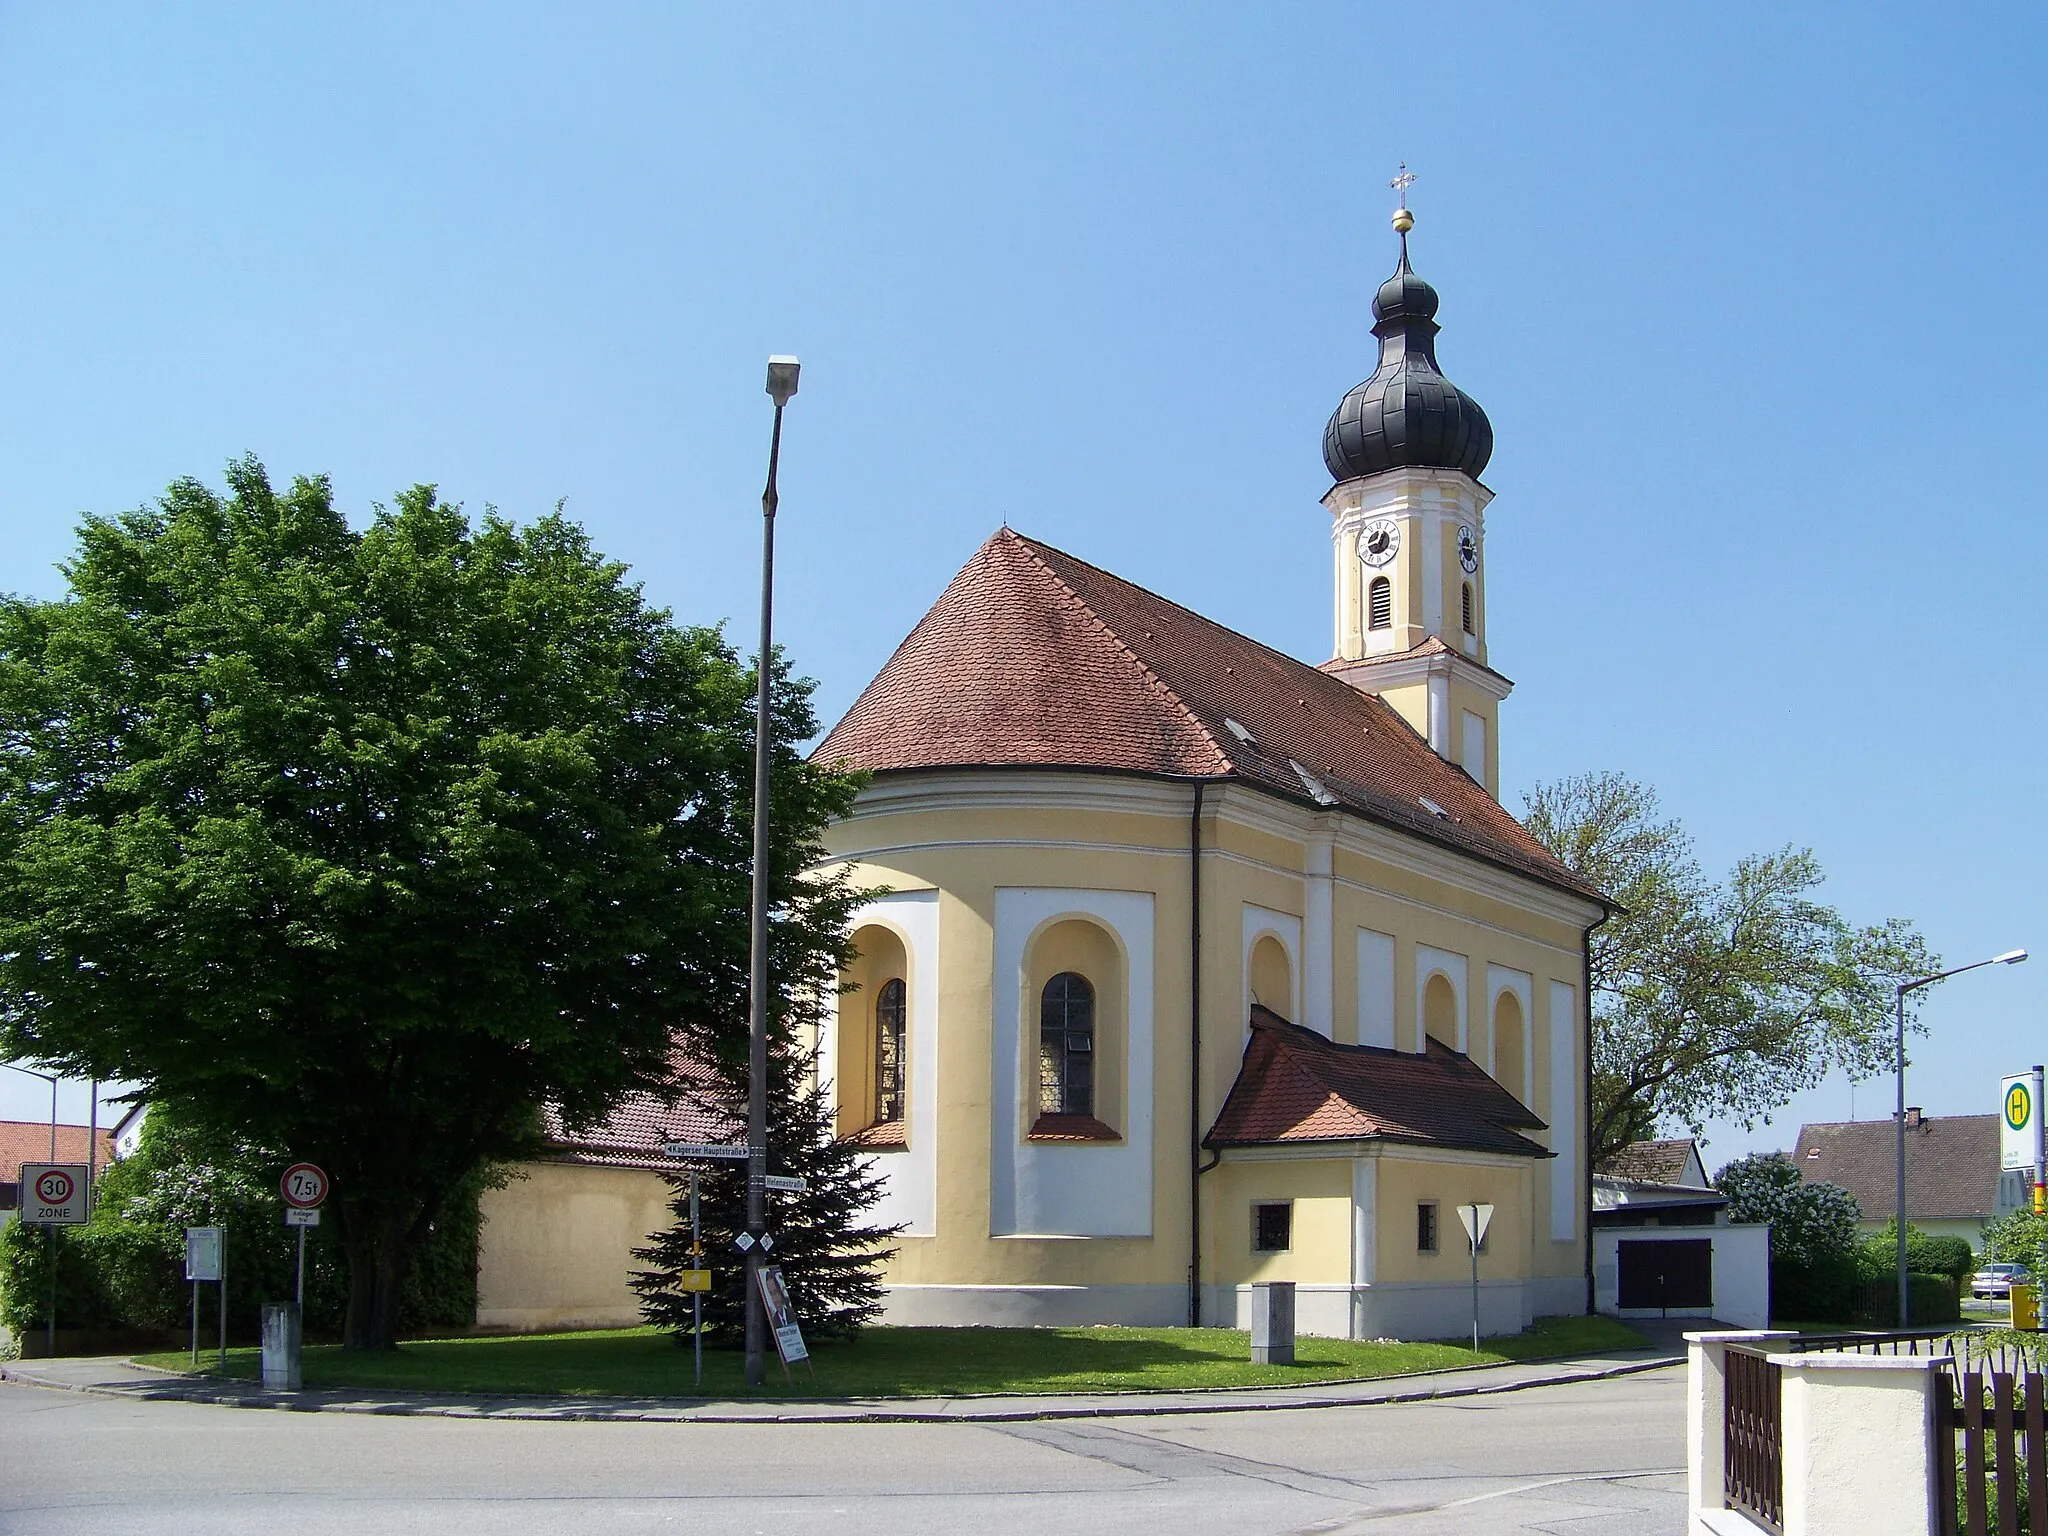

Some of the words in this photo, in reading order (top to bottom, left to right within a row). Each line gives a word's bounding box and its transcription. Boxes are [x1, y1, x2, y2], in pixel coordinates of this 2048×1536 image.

[2012, 1093, 2023, 1120] H
[703, 1146, 743, 1157] Hauptstraße
[43, 1180, 66, 1195] 30
[38, 1208, 70, 1217] ZONE
